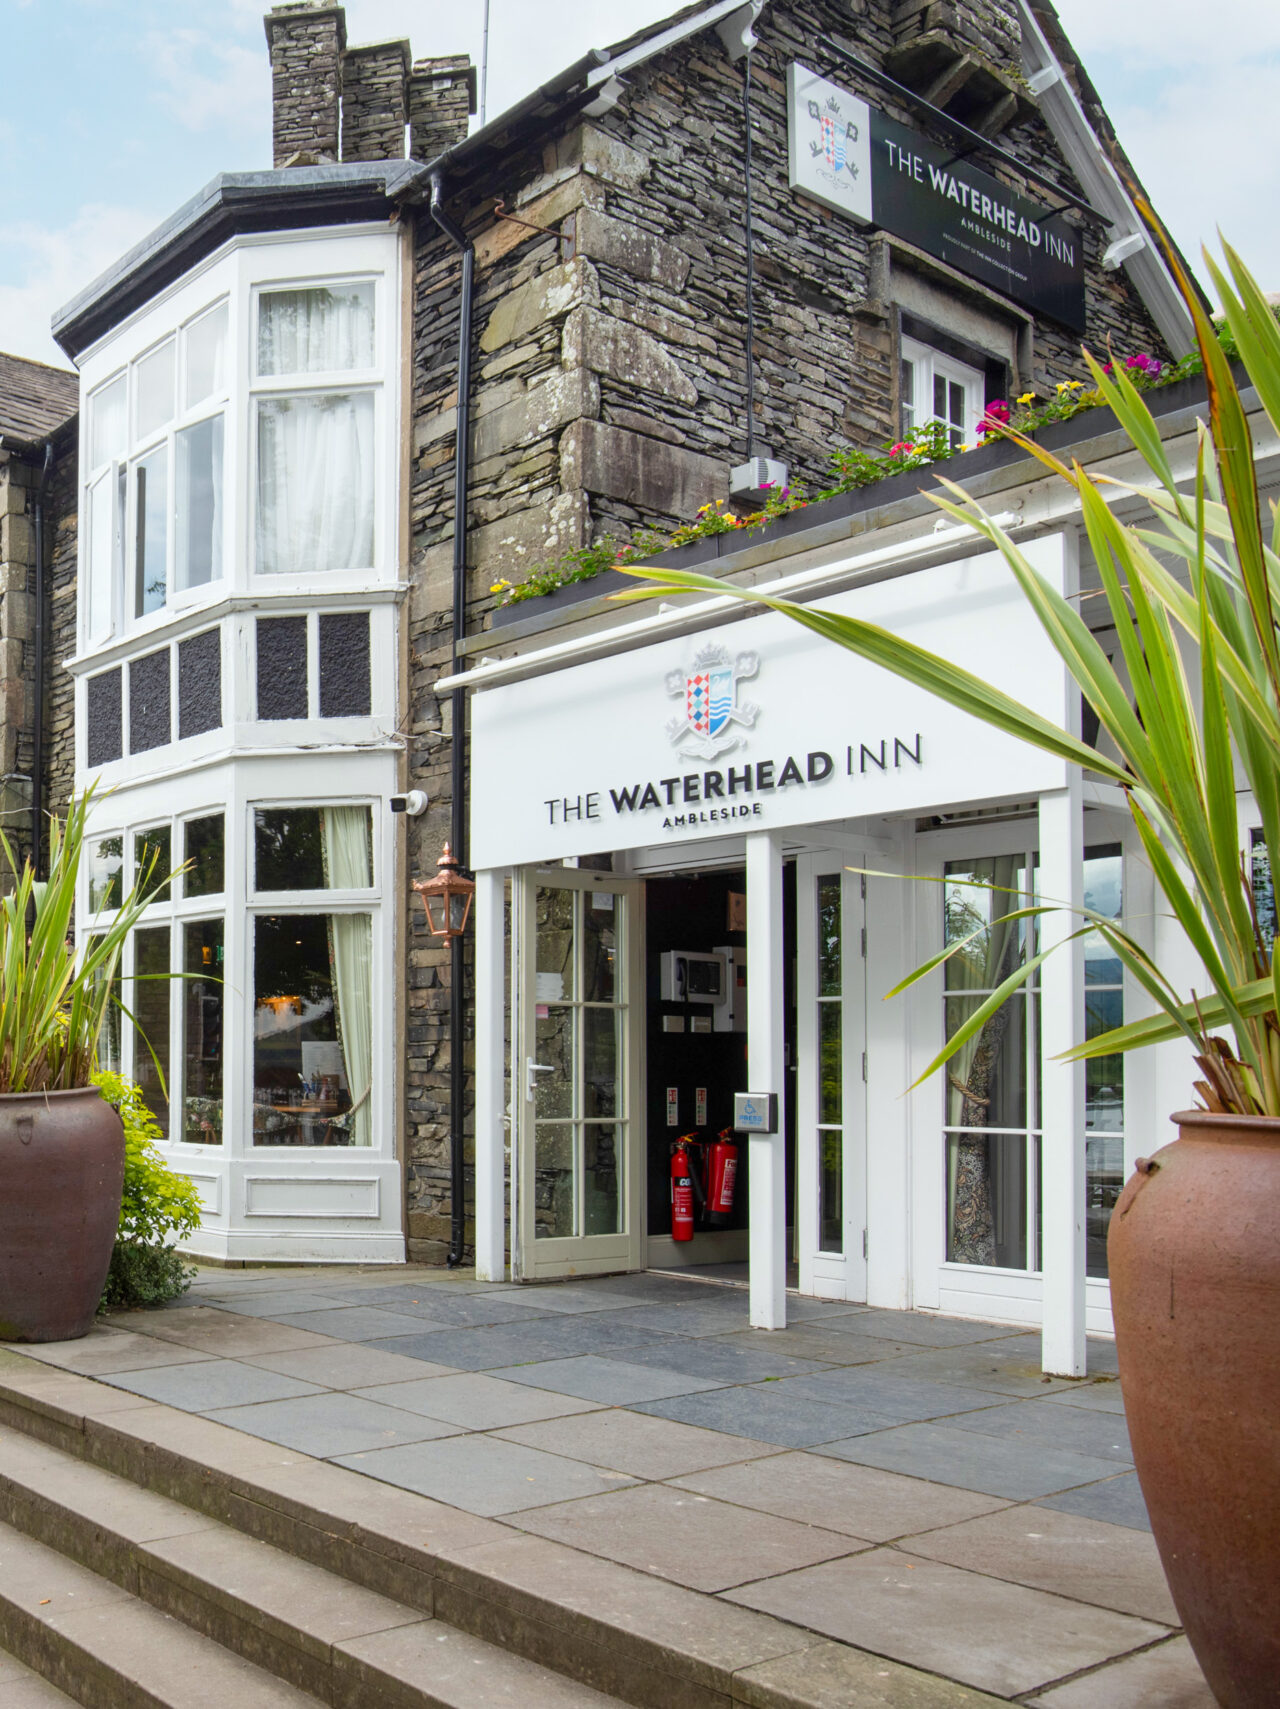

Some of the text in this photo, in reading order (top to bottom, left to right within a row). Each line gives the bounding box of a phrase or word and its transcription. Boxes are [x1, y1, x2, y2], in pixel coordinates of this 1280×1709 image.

[884, 139, 1074, 268] THE WATERHEAD INN
[960, 217, 1012, 253] AMBLESIDE
[976, 250, 985, 259] THE
[984, 255, 992, 263] INN
[991, 258, 1015, 275] COLLECTION
[1014, 271, 1028, 281] GROUP
[544, 733, 923, 825] THE WATERHEAD INN
[662, 802, 762, 829] AMBLESIDE
